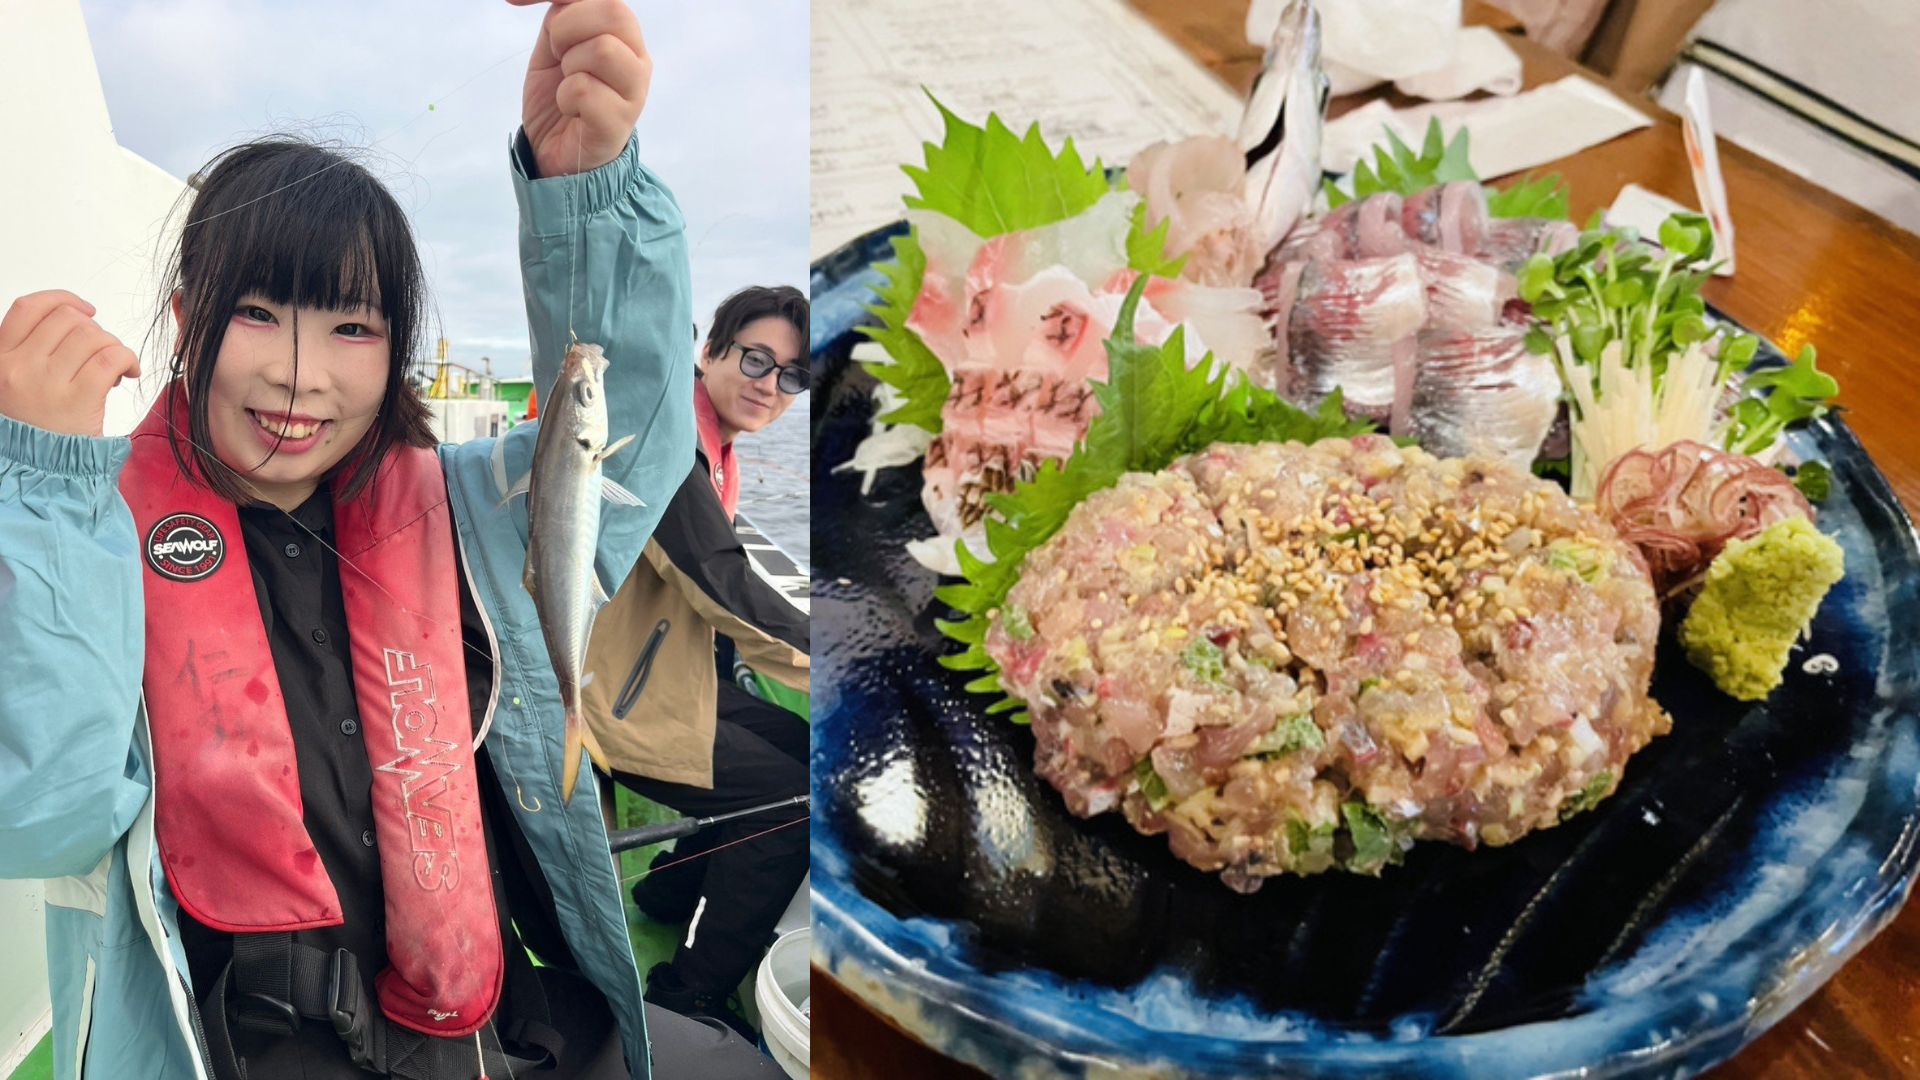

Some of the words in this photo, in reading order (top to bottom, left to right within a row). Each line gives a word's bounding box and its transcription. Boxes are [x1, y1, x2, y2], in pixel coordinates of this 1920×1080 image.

[154, 527, 167, 543] LIFE
[165, 518, 195, 529] SAFETY
[197, 522, 216, 539] GEAR
[153, 537, 218, 555] SEAWOLF
[160, 559, 193, 574] SINCE
[195, 555, 216, 572] 1991
[375, 647, 464, 891] SEAWOLF
